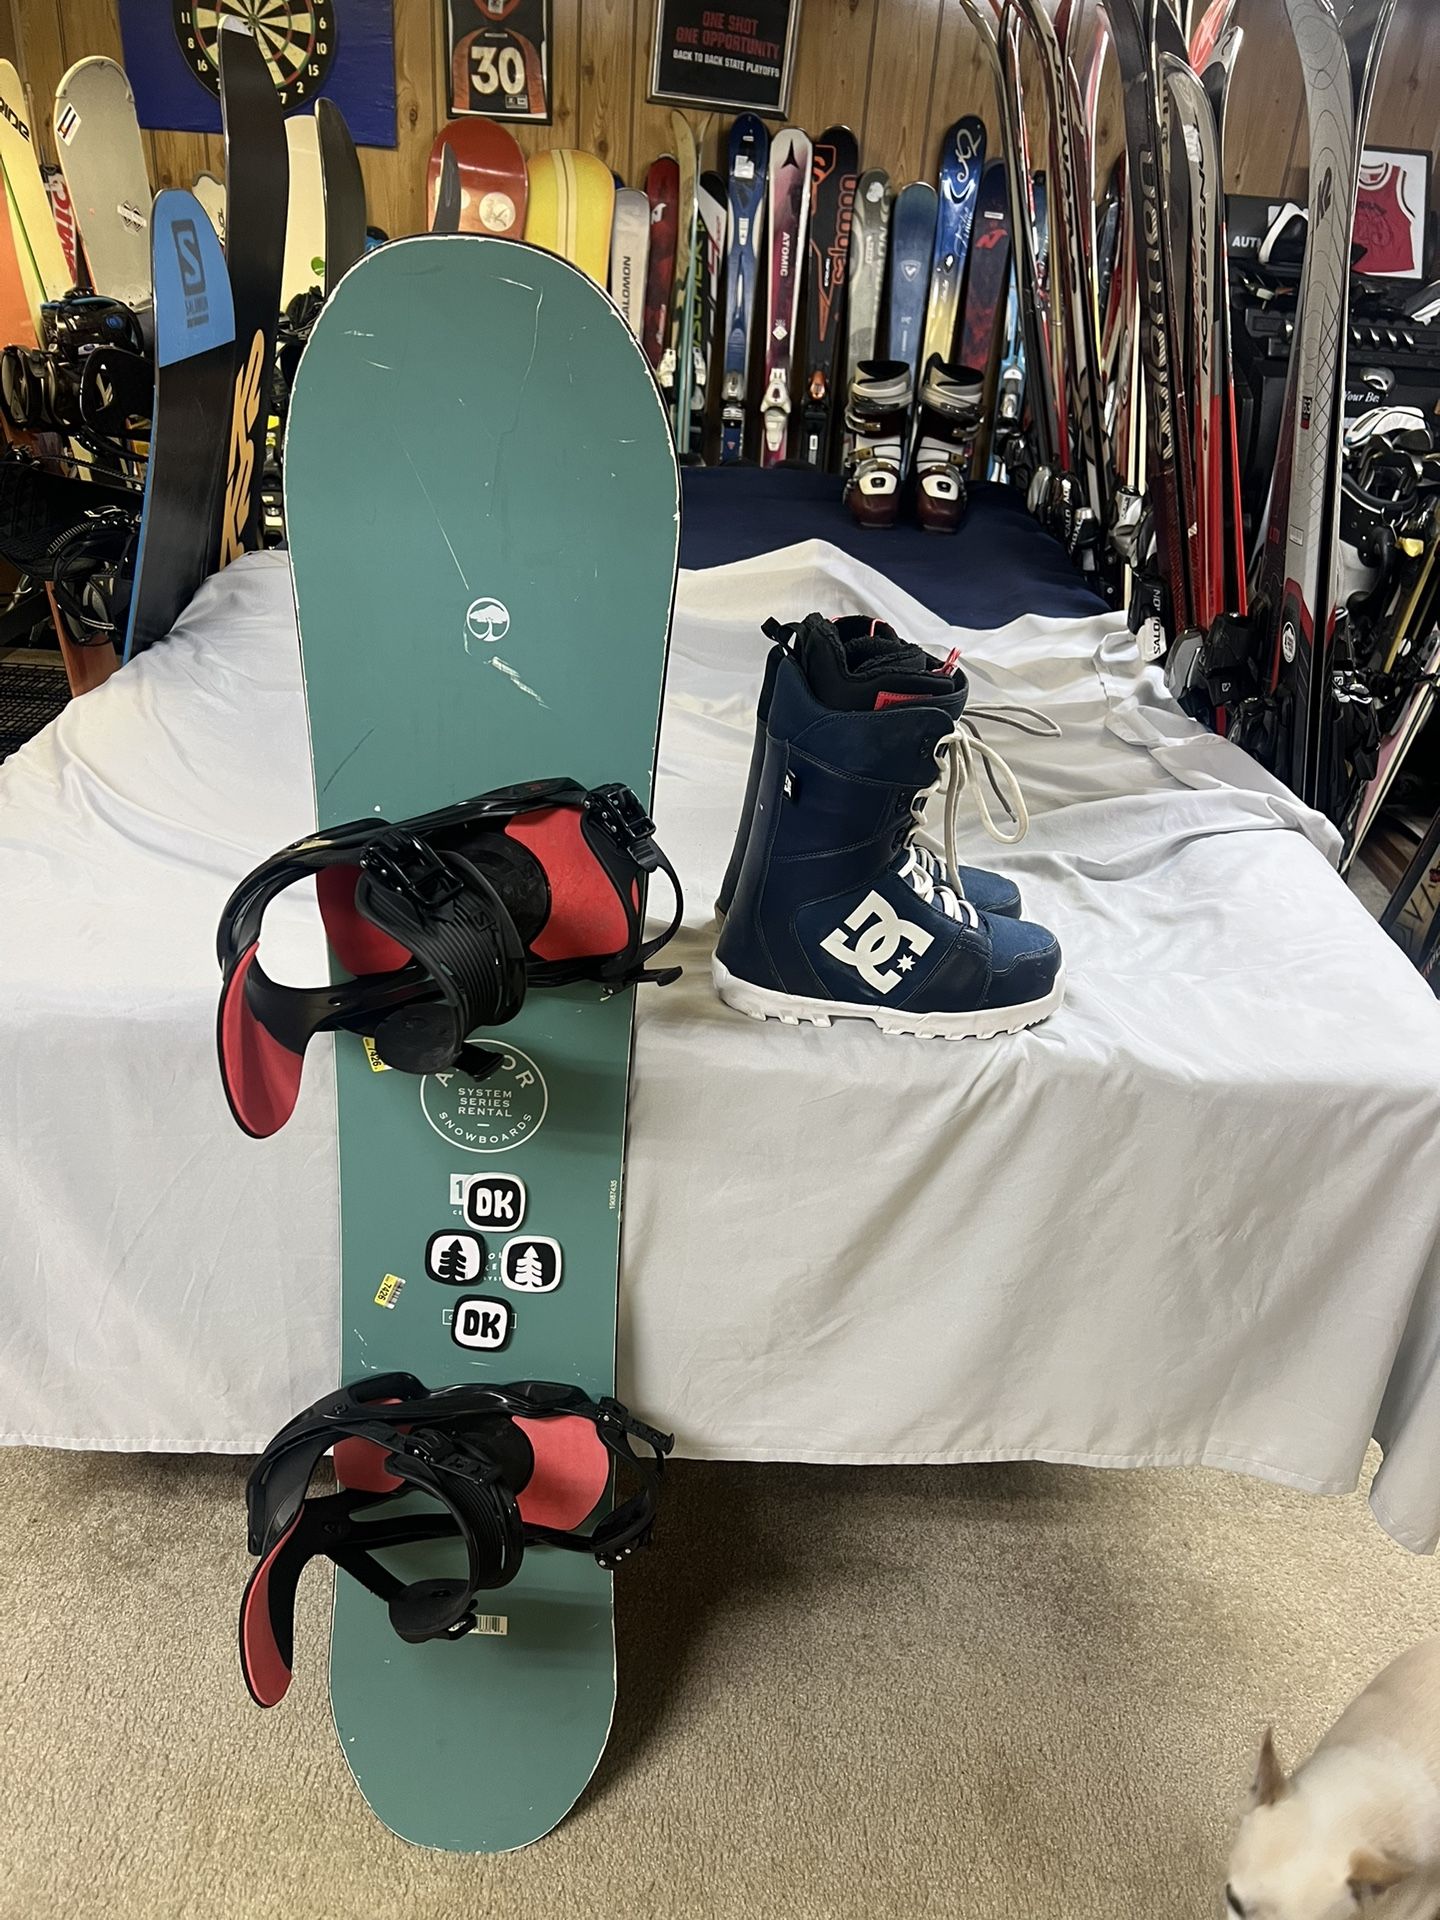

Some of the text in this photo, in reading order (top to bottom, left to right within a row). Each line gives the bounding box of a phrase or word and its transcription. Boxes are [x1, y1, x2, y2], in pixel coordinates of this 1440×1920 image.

[181, 12, 191, 24] 11
[319, 17, 327, 30] 6
[702, 11, 759, 36] ONE SHOT
[187, 37, 195, 49] 8
[316, 43, 327, 55] 10
[676, 26, 780, 59] ONE OPPORTUNITY
[197, 60, 208, 72] 16
[308, 64, 319, 76] 15
[471, 46, 525, 94] 30
[673, 49, 780, 78] BACK TO BACK STATE PLAYOFFS
[296, 82, 304, 94] 2
[780, 231, 791, 277] ATOMIC
[819, 889, 935, 994] DC
[435, 1054, 535, 1088] AOR
[458, 1087, 512, 1098] SYSTEM
[458, 1107, 512, 1117] RENTAL
[460, 1097, 510, 1108] SERIES
[439, 1112, 532, 1144] SNOWBOARDS
[475, 1187, 514, 1219] DK
[463, 1308, 501, 1340] DK
